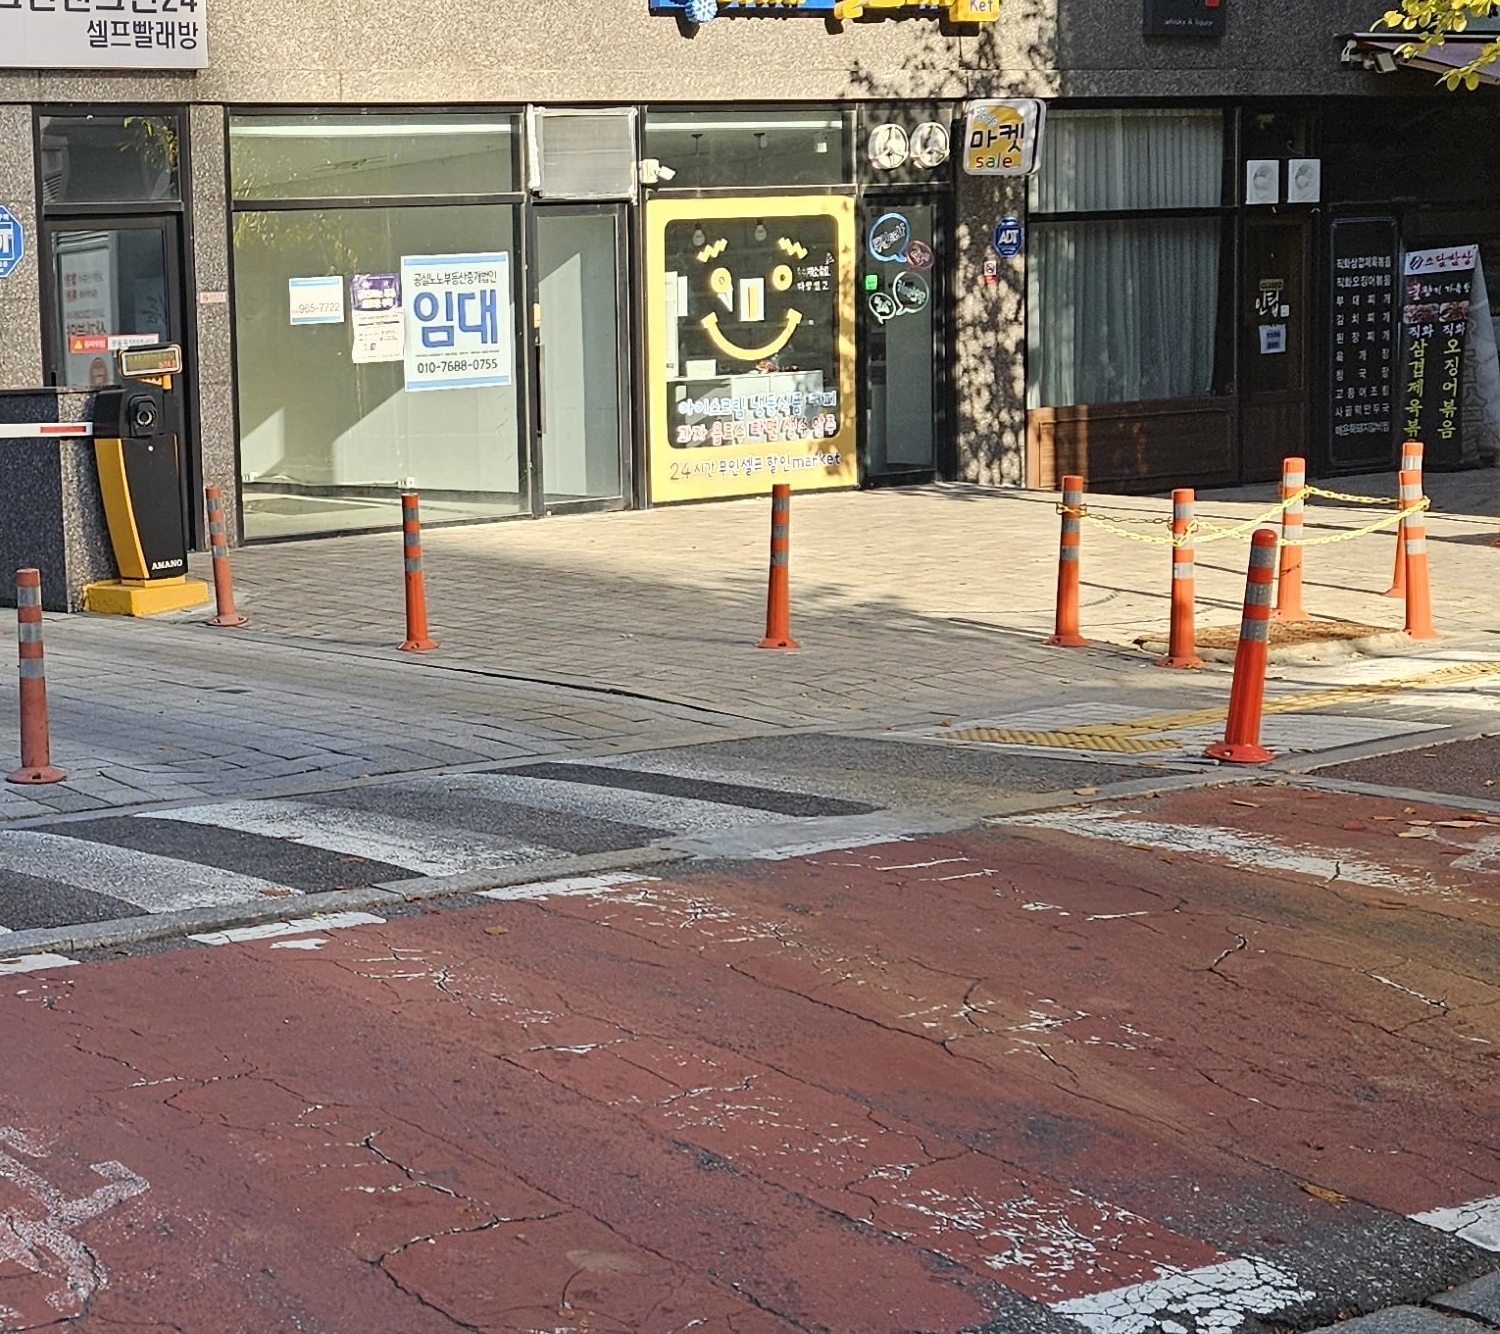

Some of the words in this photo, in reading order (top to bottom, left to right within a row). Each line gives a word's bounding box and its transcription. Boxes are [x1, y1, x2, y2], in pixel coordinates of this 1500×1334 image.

[86, 19, 199, 50] 셀프빨래방
[970, 123, 1025, 153] 마켓
[975, 152, 1013, 169] sale
[998, 229, 1019, 245] ADT
[413, 289, 498, 348] 임대
[1442, 322, 1466, 337] 직화
[1408, 323, 1435, 339] 직화
[417, 358, 498, 374] 010-7688-0755
[1403, 338, 1429, 442] 삼겹제육볶
[1436, 338, 1462, 440] 오징어볶음
[678, 397, 746, 420] 아이스크림
[749, 392, 803, 417] 냉동식품
[676, 424, 708, 443] 과자
[669, 461, 716, 481] 24시간
[718, 455, 763, 476] 무인셀프
[151, 558, 183, 571] AMANO
